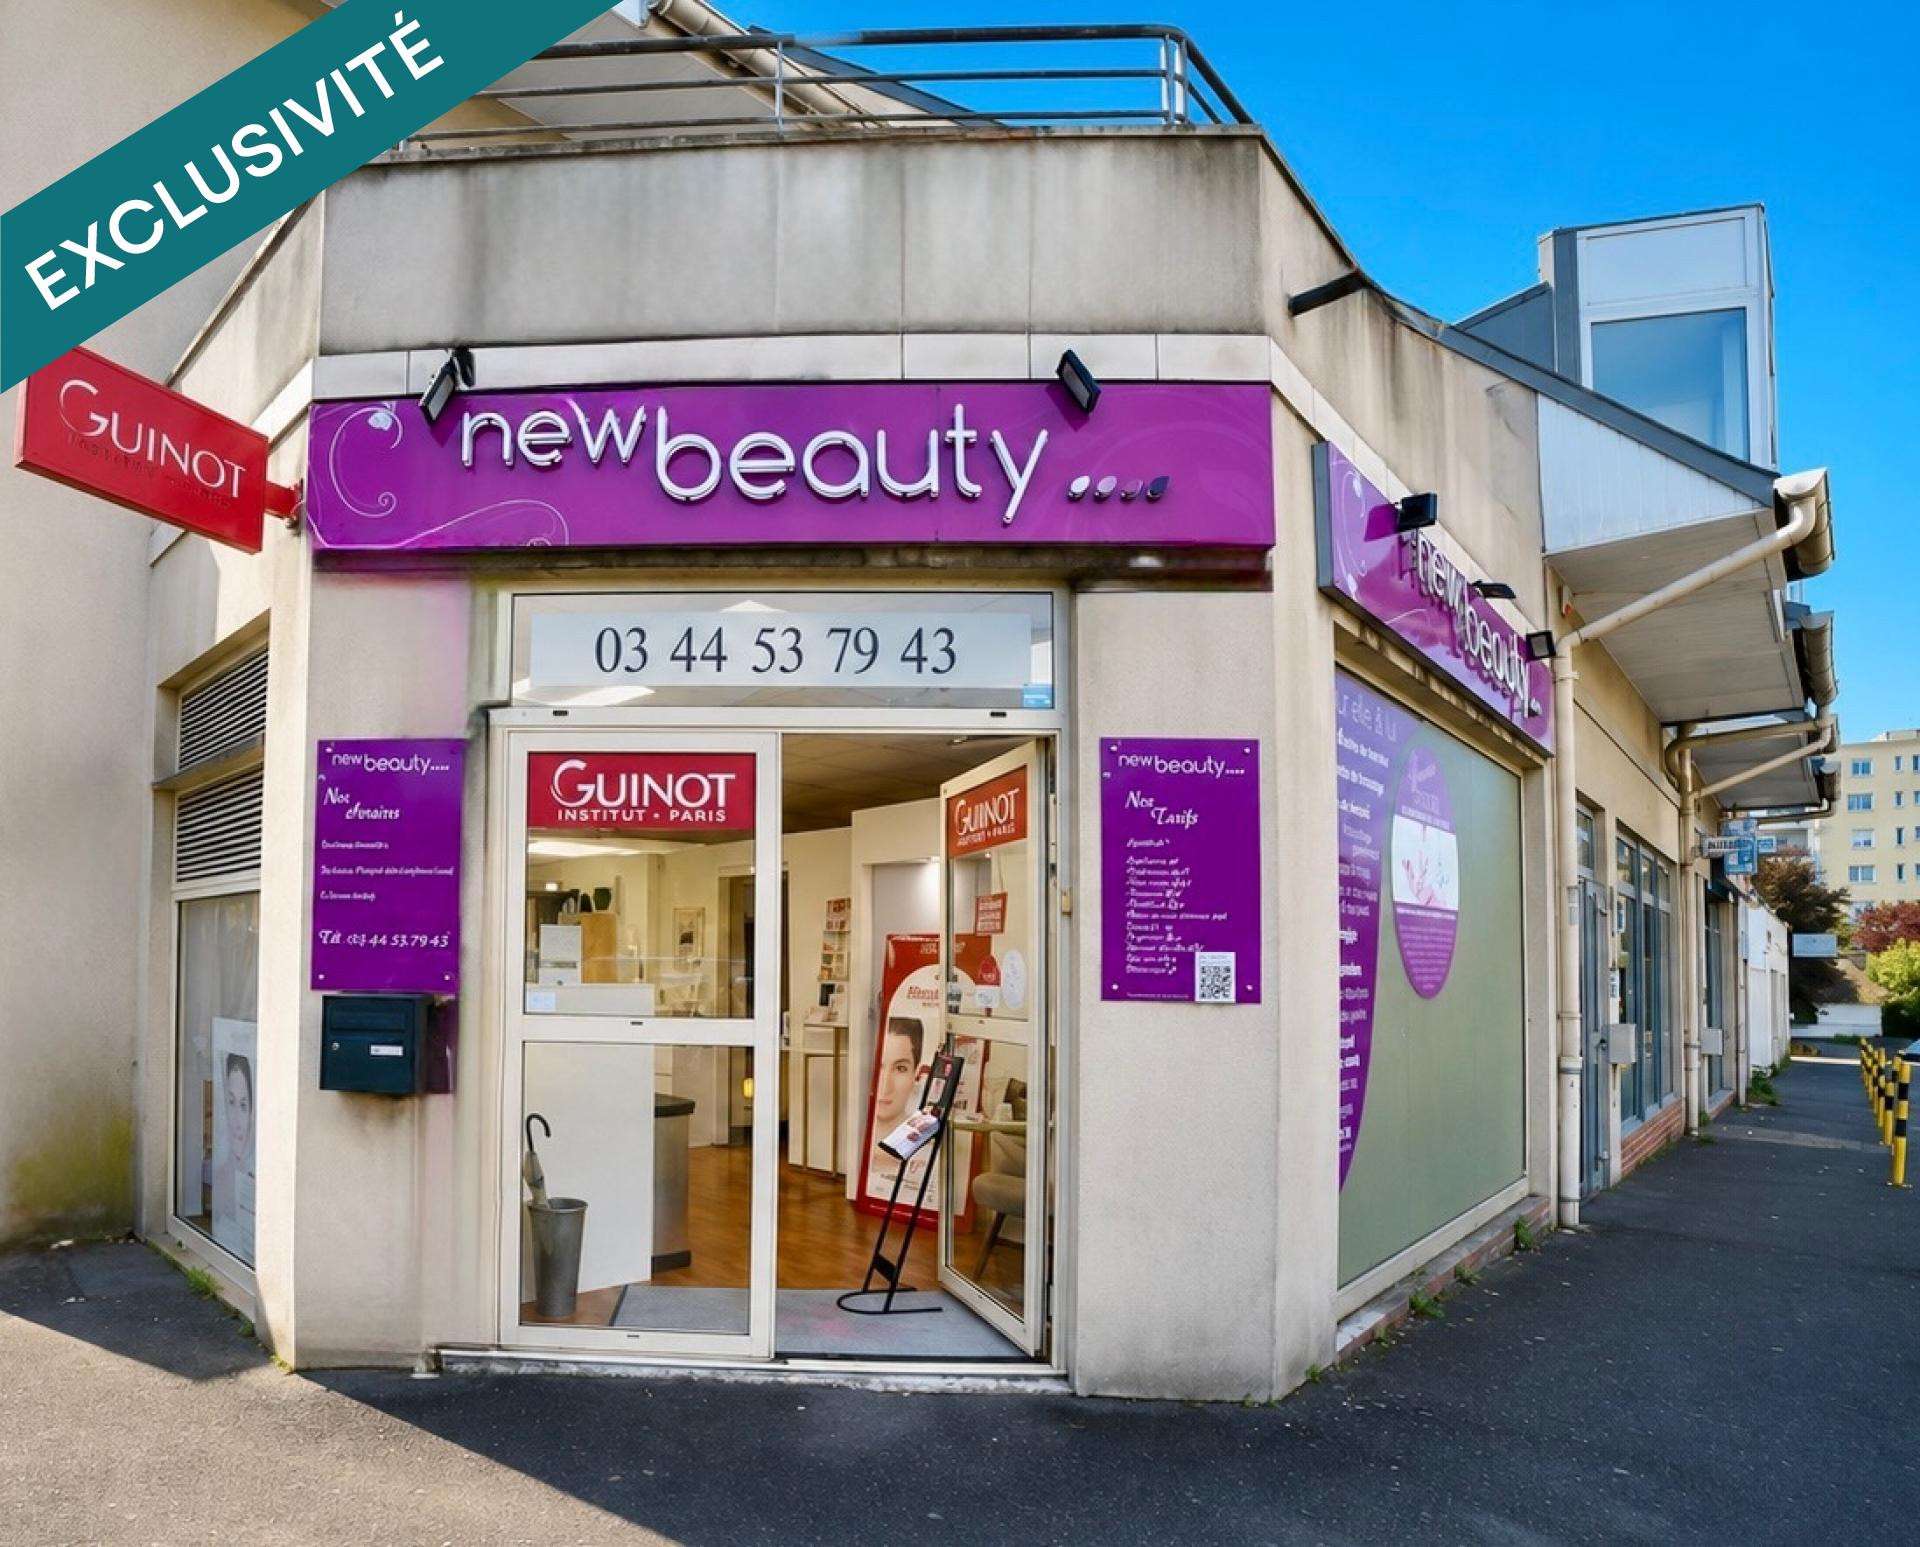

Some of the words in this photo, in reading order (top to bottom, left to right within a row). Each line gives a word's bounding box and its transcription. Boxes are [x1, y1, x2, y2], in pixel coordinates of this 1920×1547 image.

[58, 379, 247, 498] GUINOT
[594, 627, 648, 673] 03
[669, 627, 729, 673] 44
[751, 627, 803, 674] 53
[826, 627, 880, 674] 79
[900, 627, 957, 674] 43
[551, 758, 736, 808] GUINOT
[557, 809, 647, 822] INSTITUT
[669, 809, 727, 822] PARIS
